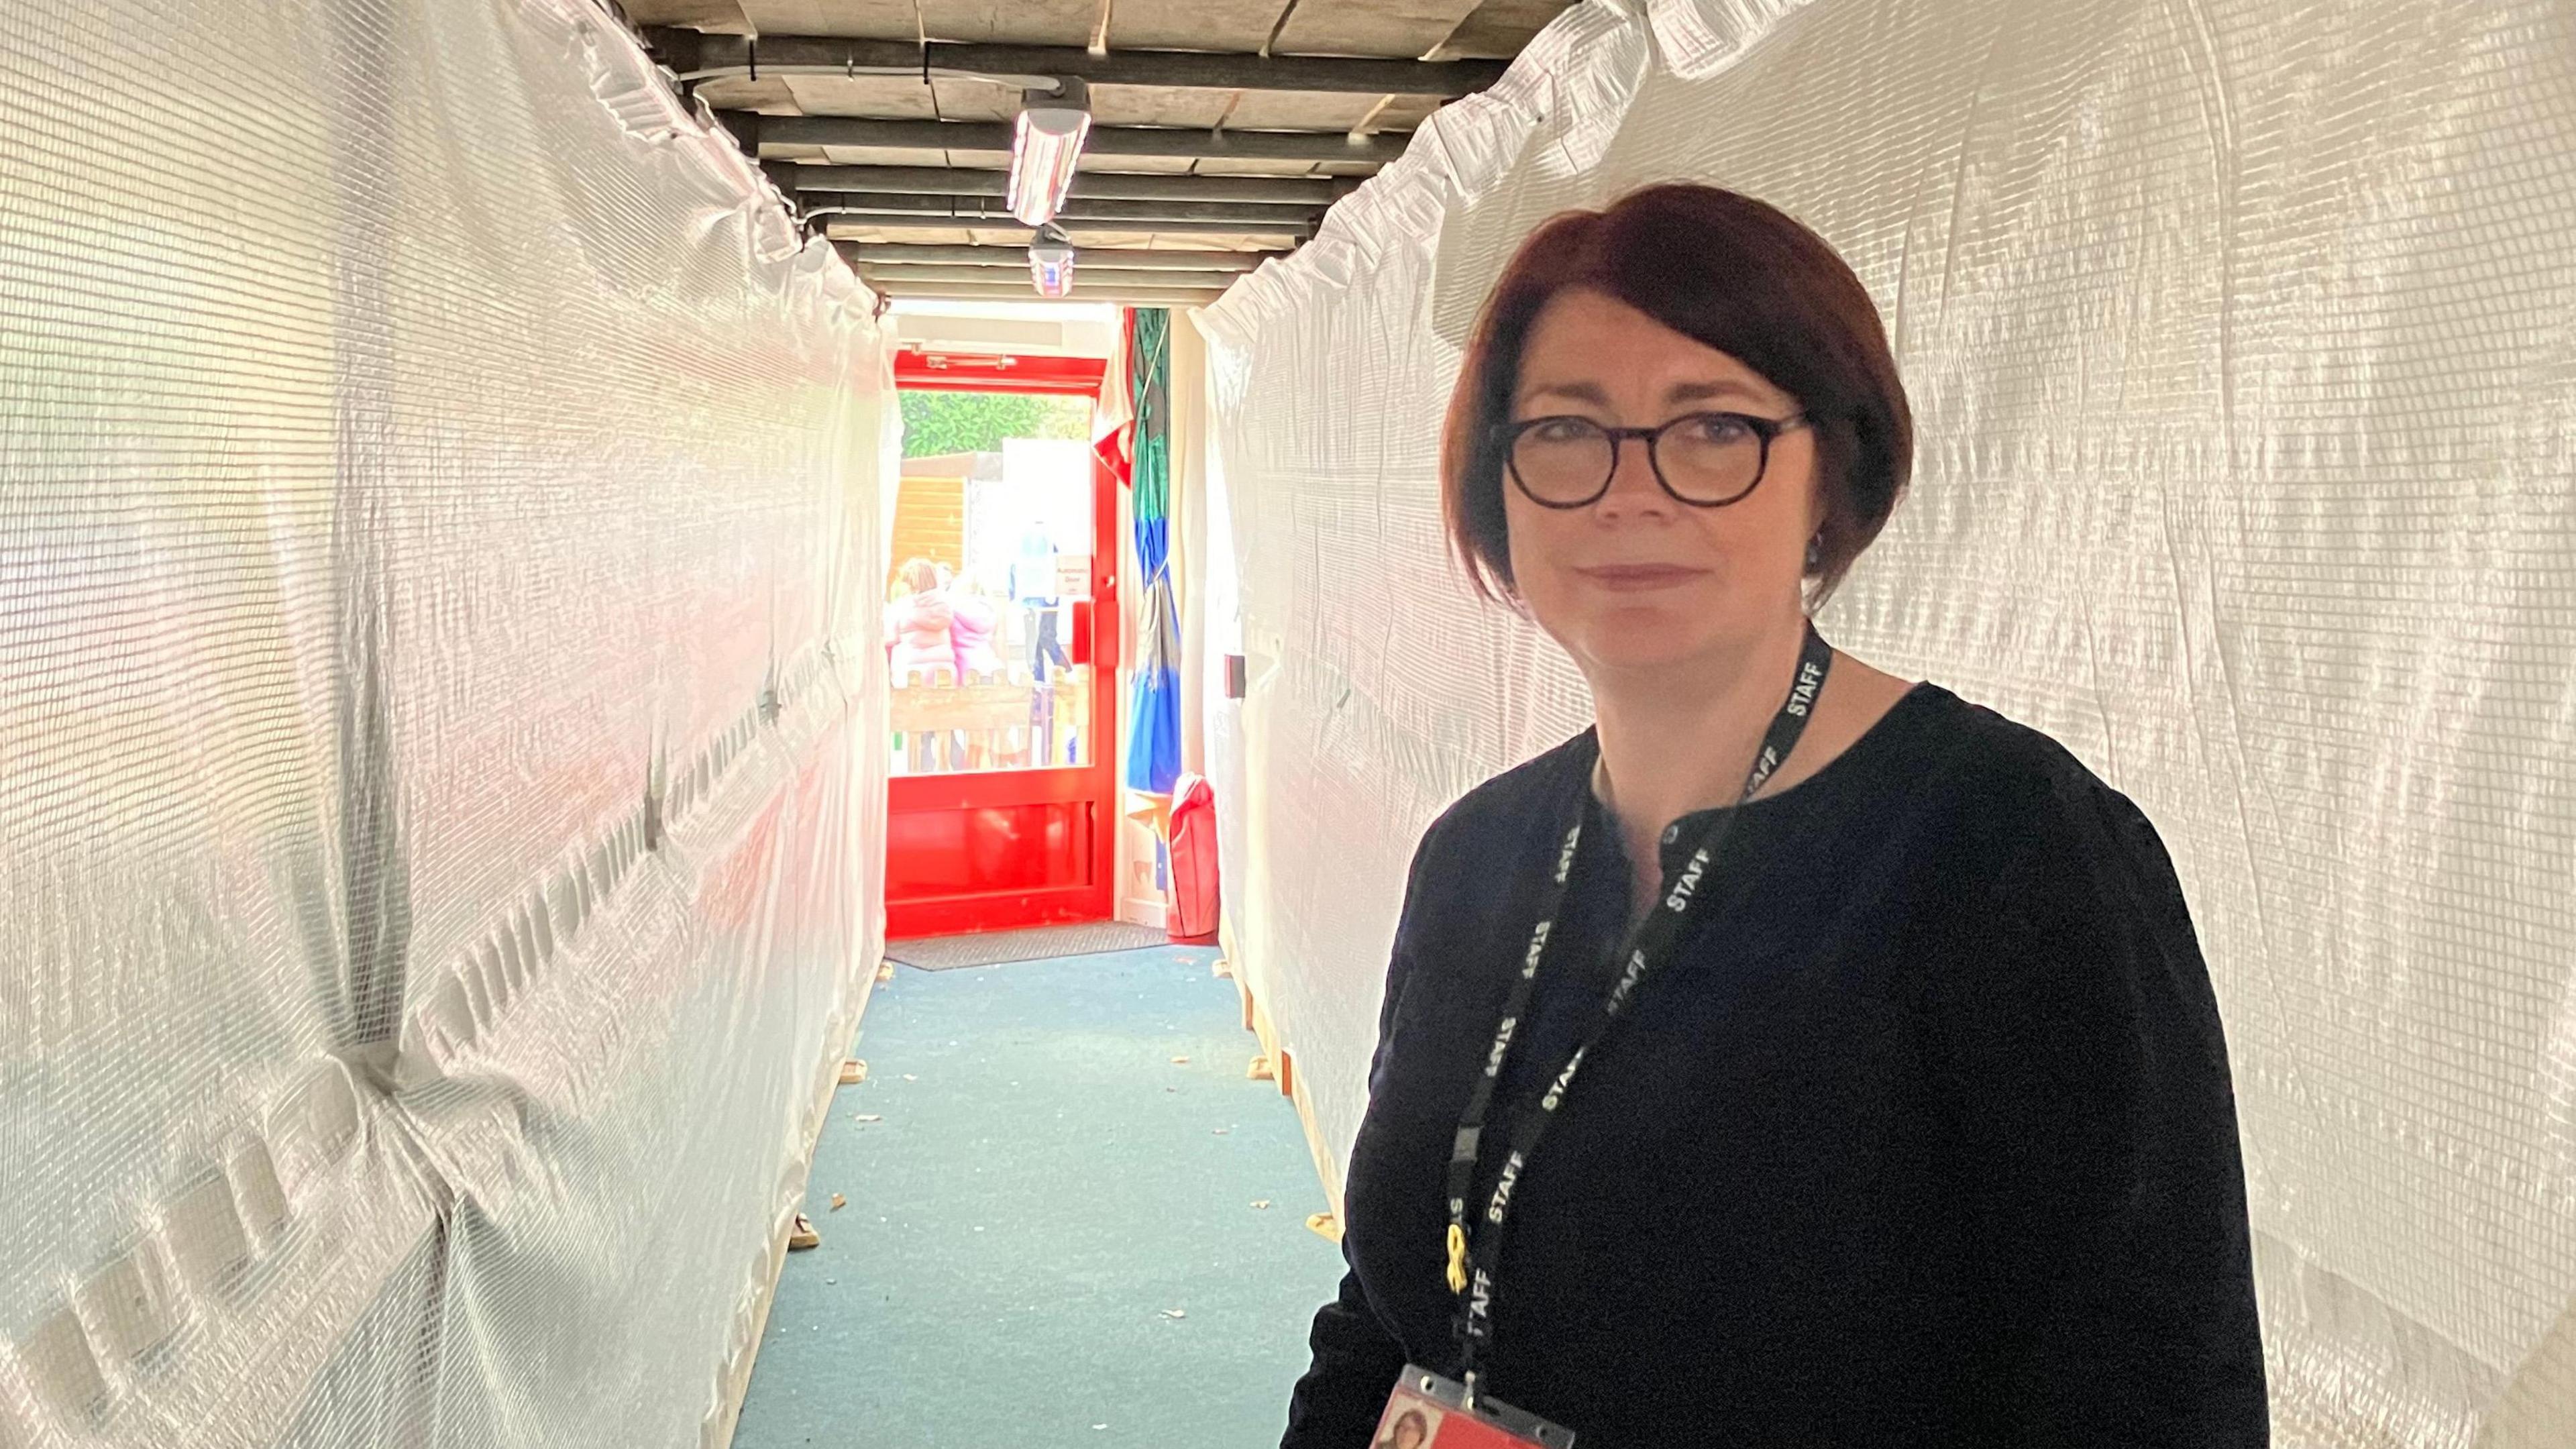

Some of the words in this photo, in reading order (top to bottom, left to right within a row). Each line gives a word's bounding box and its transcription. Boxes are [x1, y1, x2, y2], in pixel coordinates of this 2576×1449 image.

[1787, 662, 1823, 716] STAFF
[1748, 746, 1778, 794] AFF
[1666, 848, 1709, 912] STAFF
[1489, 1150, 1523, 1222] STAFF
[1468, 1268, 1491, 1336] TAFF
